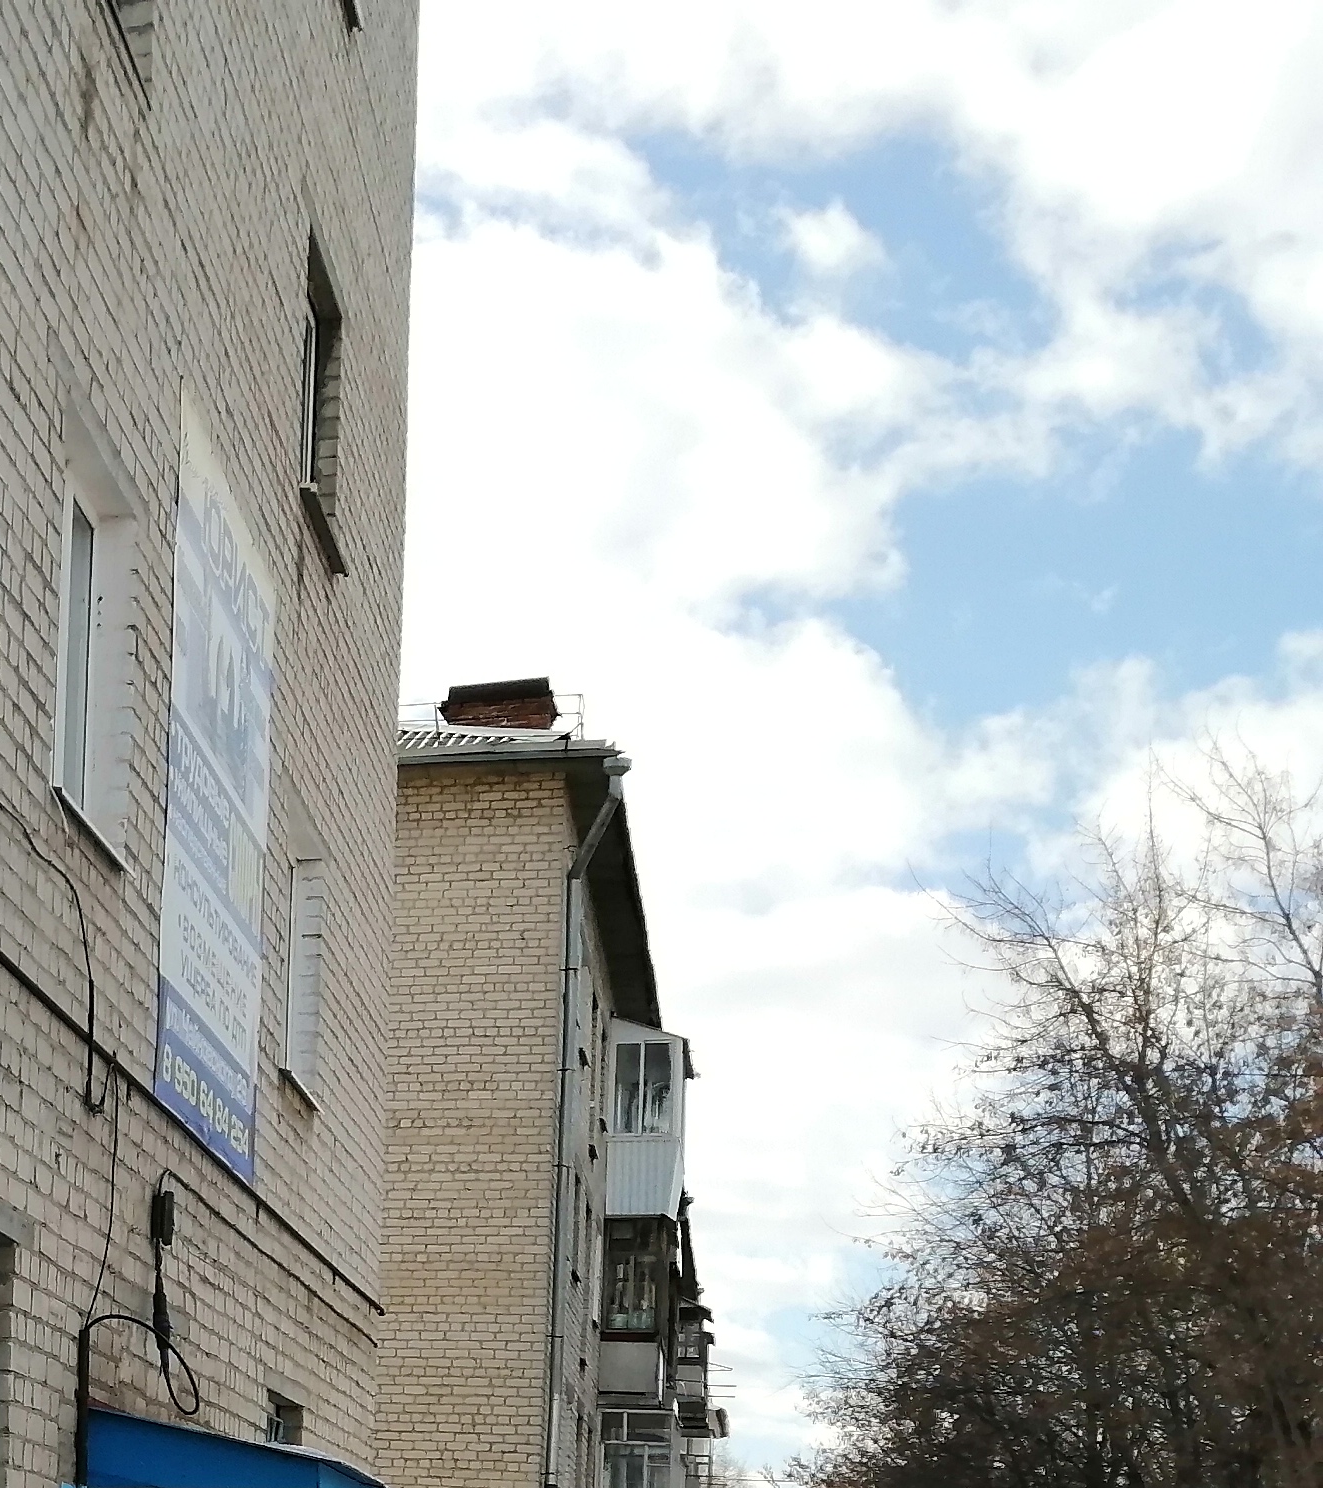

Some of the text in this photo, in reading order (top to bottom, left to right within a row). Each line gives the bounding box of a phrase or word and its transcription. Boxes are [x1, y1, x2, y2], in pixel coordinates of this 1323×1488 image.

[202, 489, 270, 672] ЮРИСТ
[163, 1044, 173, 1083] 8
[175, 1056, 197, 1106] 950
[200, 1081, 214, 1124] 64
[216, 1098, 229, 1139] 84
